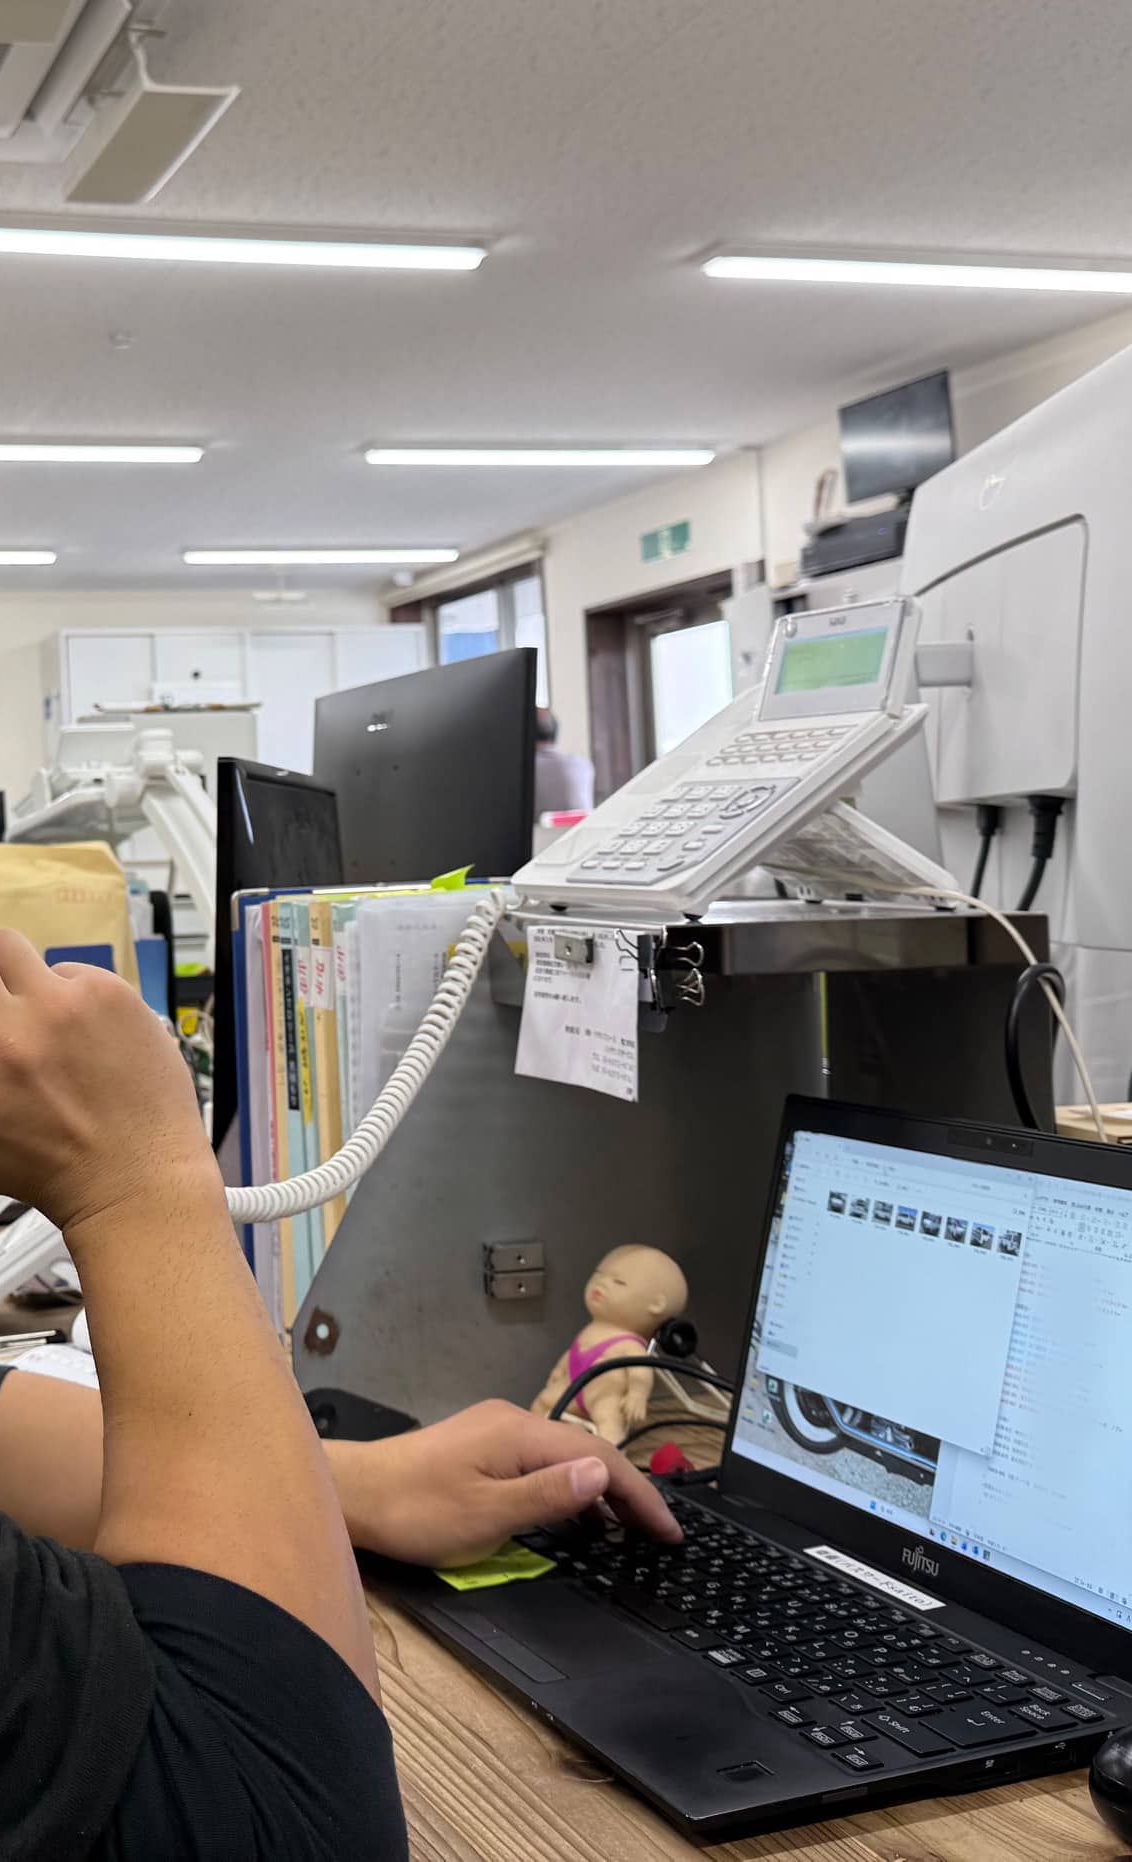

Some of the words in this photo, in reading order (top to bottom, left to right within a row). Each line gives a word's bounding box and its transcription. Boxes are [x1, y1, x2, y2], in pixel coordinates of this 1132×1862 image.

[902, 1545, 940, 1577] FUJITSU
[980, 1709, 1007, 1725] Enter
[888, 1720, 911, 1734] Shift
